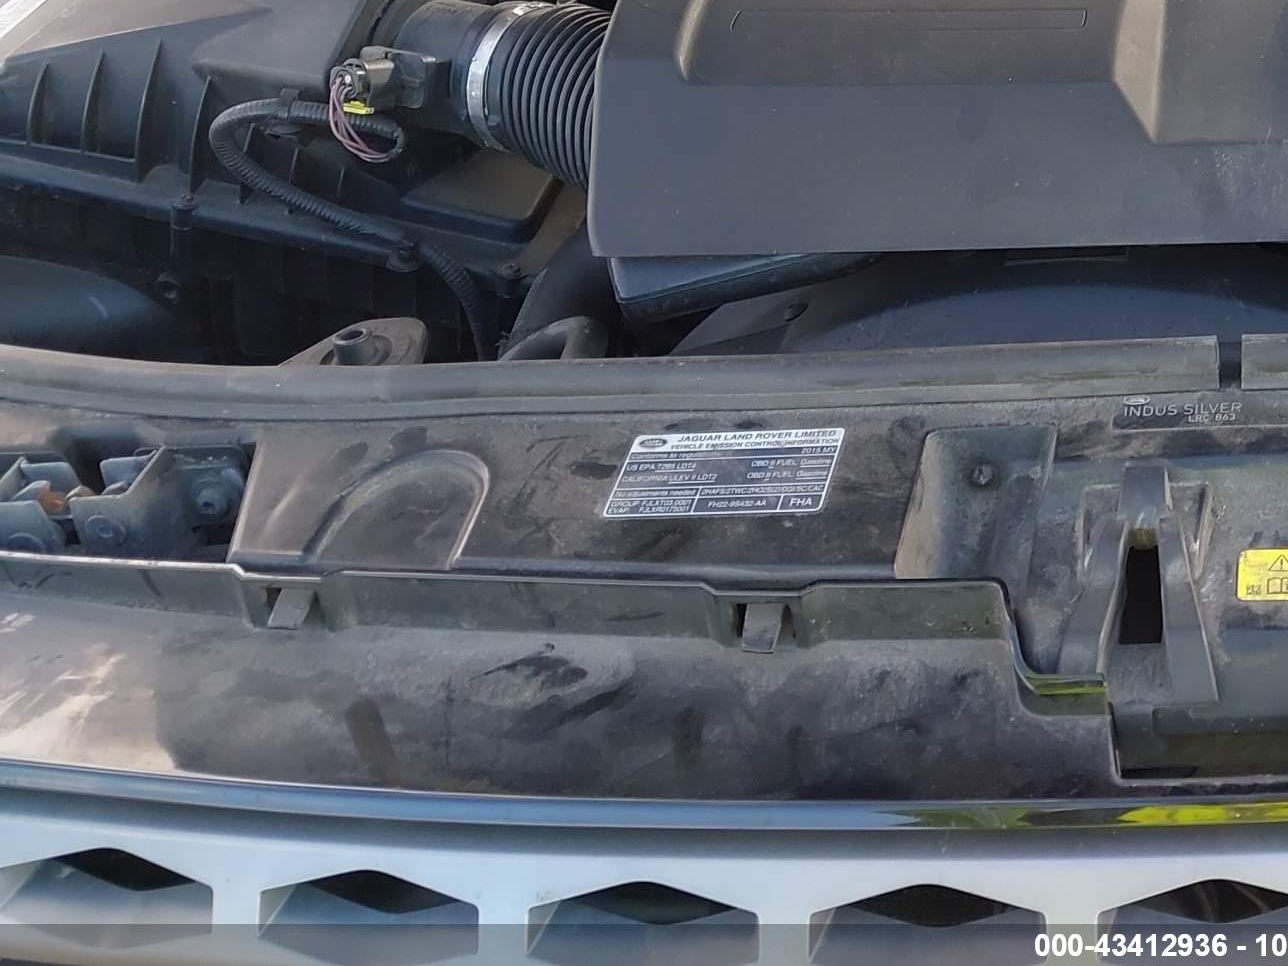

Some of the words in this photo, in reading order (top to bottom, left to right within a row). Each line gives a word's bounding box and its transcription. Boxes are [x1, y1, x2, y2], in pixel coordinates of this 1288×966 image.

[1124, 404, 1177, 417] INDUS
[1184, 402, 1242, 414] SILVER
[755, 432, 792, 440] ROVER
[794, 430, 837, 438] LIMITED
[671, 442, 704, 450] VEHICLE
[822, 446, 837, 454] MY
[789, 498, 812, 506] FHA
